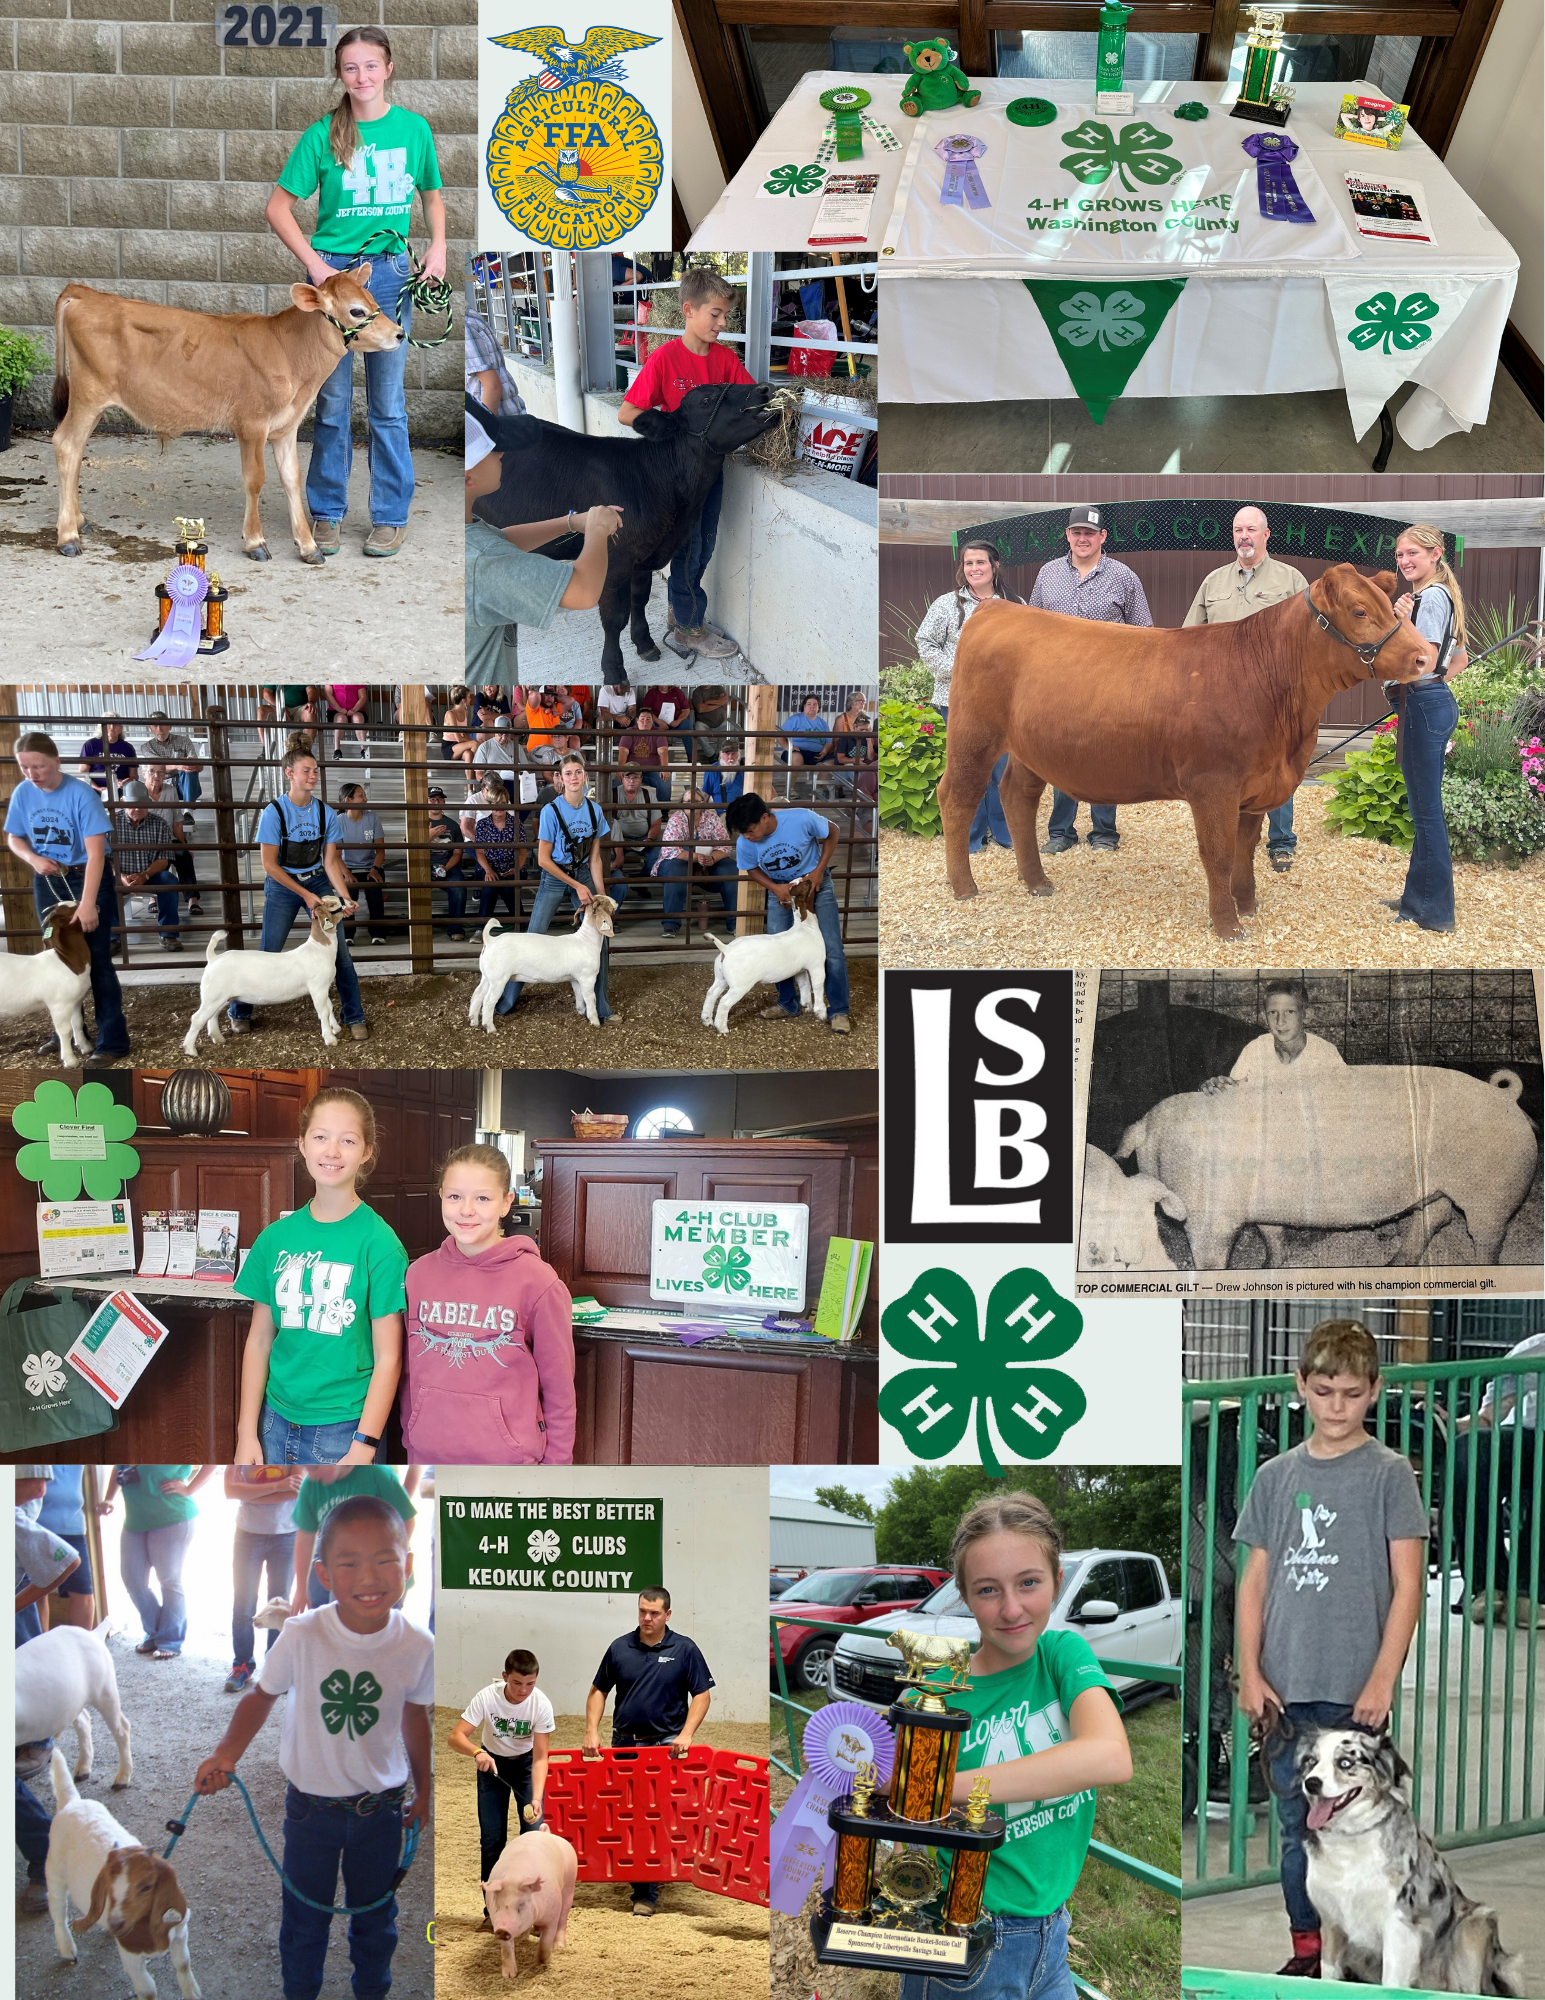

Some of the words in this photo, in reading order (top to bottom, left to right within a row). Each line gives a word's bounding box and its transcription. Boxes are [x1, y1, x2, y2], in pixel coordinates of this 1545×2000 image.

[224, 5, 327, 47] 2021
[1363, 99, 1386, 109] imagine
[515, 101, 635, 152] AGRICULTURAL
[543, 122, 610, 148] FFA
[336, 207, 384, 218] JEFFERSON
[524, 191, 626, 225] EDUCATION
[1027, 197, 1069, 211] 4-H
[1077, 197, 1164, 212] GROWS
[1026, 216, 1157, 234] Washington
[1165, 215, 1239, 234] County
[804, 421, 864, 456] ACE
[1172, 516, 1219, 540] CO
[1325, 525, 1399, 557] EXP
[770, 848, 787, 857] 2024
[675, 1210, 712, 1225] 4-H
[719, 1212, 778, 1227] CLUB
[664, 1226, 790, 1247] MEMBER
[272, 1249, 323, 1275] Iowa
[656, 1278, 704, 1293] LIVES
[749, 1285, 799, 1300] HERE
[1076, 1284, 1099, 1293] TOP
[1101, 1283, 1173, 1293] COMMERCIAL
[1175, 1283, 1199, 1292] GILT
[1215, 1283, 1241, 1292] Drew
[1243, 1282, 1283, 1292] Johnson
[1285, 1282, 1293, 1291] is
[1296, 1282, 1334, 1292] pictured
[1336, 1281, 1356, 1290] with
[1358, 1280, 1373, 1290] his
[1375, 1280, 1421, 1291] champion
[1423, 1279, 1477, 1289] commercial
[1479, 1279, 1497, 1290] gilt.
[275, 1260, 354, 1336] 4-H
[419, 1300, 515, 1332] CABELA'S
[451, 1338, 467, 1349] 1961
[41, 1402, 58, 1410] Grows
[446, 1501, 466, 1519] TO
[470, 1502, 513, 1519] MAKE
[517, 1503, 547, 1520] THE
[552, 1503, 591, 1520] BEST
[596, 1503, 655, 1521] BETTER
[478, 1535, 509, 1554] 4-H
[572, 1536, 627, 1556] CLUBS
[468, 1568, 546, 1587] KEOKUK
[552, 1570, 634, 1589] COUNTY
[494, 1720, 532, 1736] 4-H
[962, 1700, 1030, 1753] Iowa
[854, 1760, 878, 1783] 20
[970, 1775, 991, 1797] 21
[805, 1801, 829, 1819] CHAMP
[812, 1794, 832, 1808] RESE
[1005, 1808, 1055, 1843] FERSON
[782, 1855, 817, 1873] JEFFERSON
[783, 1864, 810, 1879] COUNTY
[785, 1873, 800, 1883] FAIR
[891, 1886, 911, 1900] COUNTY
[836, 1927, 856, 1936] Reserve
[857, 1929, 883, 1939] Champion
[884, 1932, 916, 1943] Intermediate
[917, 1936, 951, 1947] Bucket-Bottle
[847, 1938, 874, 1949] Sponsored
[875, 1941, 882, 1950] by
[882, 1942, 911, 1953] Libertyville
[912, 1946, 932, 1956] Savings
[933, 1948, 947, 1957] Bank
